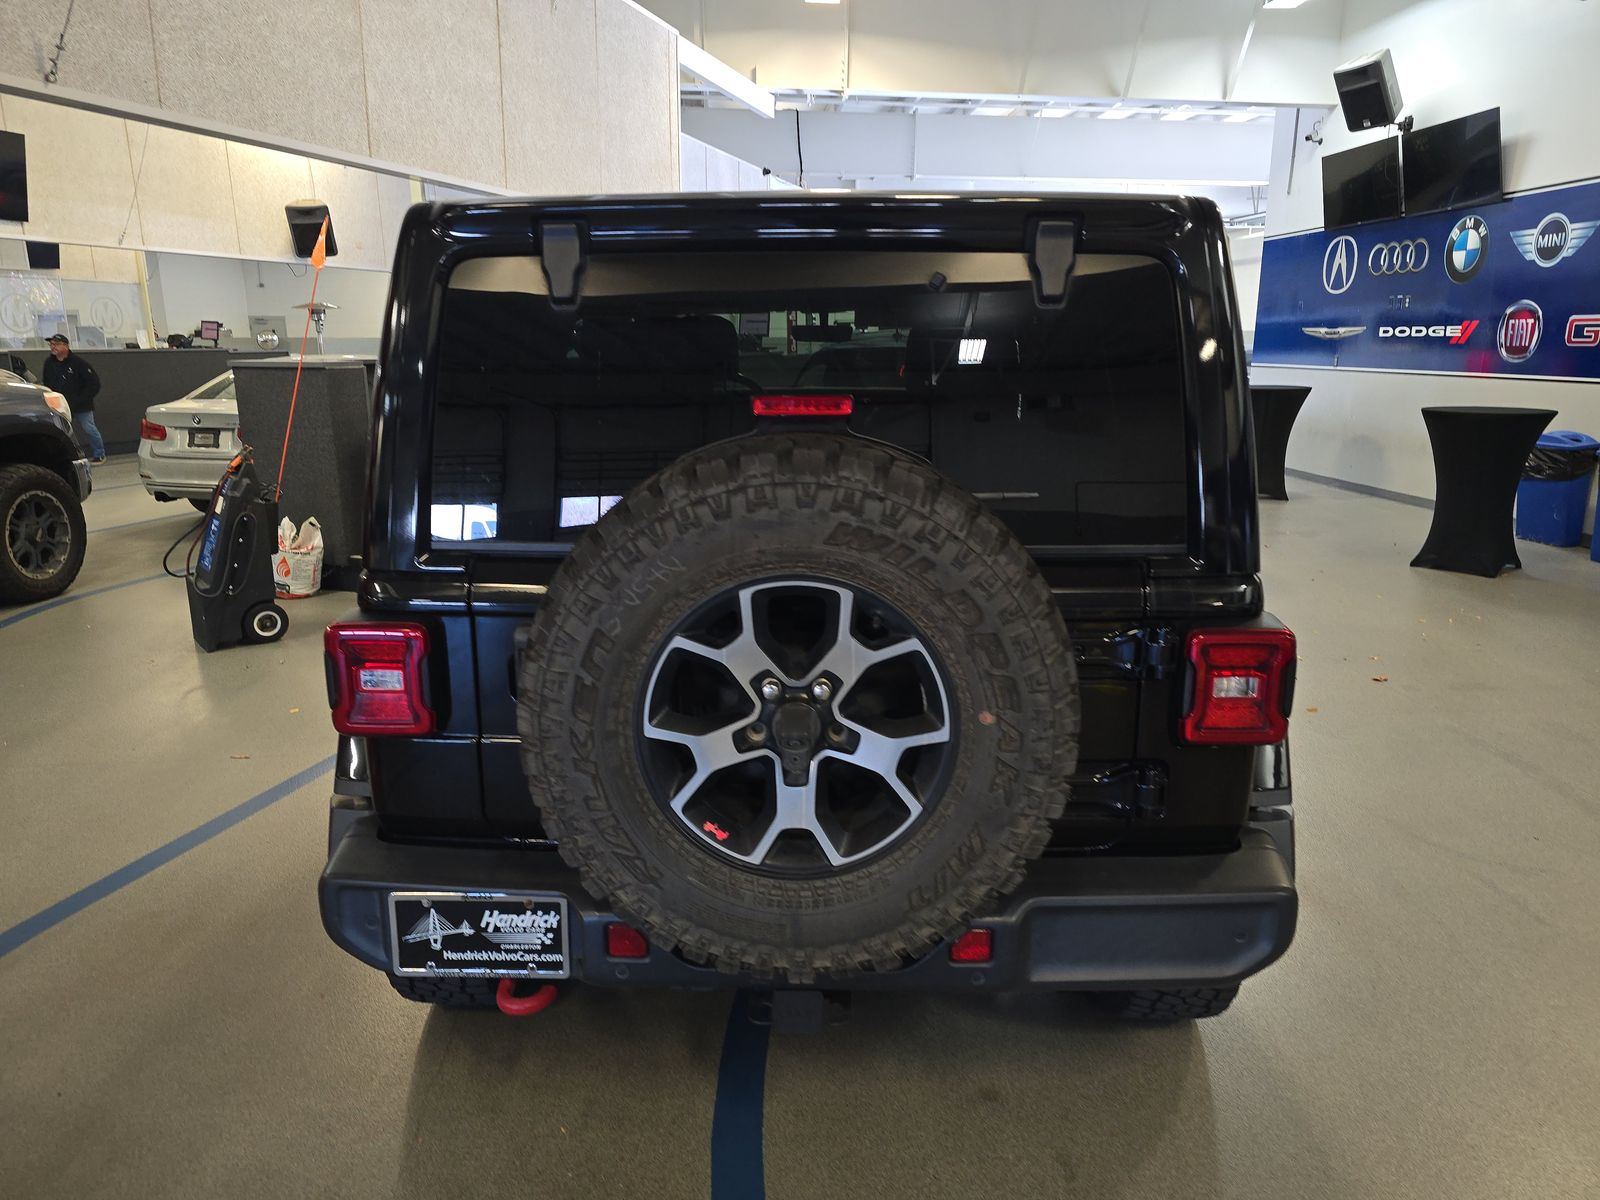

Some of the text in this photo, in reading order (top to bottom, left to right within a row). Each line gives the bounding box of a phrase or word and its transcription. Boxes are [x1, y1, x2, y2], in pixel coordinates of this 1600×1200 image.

[1451, 217, 1487, 241] BMW
[1537, 231, 1566, 249] MINI
[1378, 325, 1462, 338] DODGE
[1506, 318, 1535, 347] FIAT
[480, 910, 560, 932] Hendrick
[443, 950, 563, 962] HendrickVolvoCars.com
